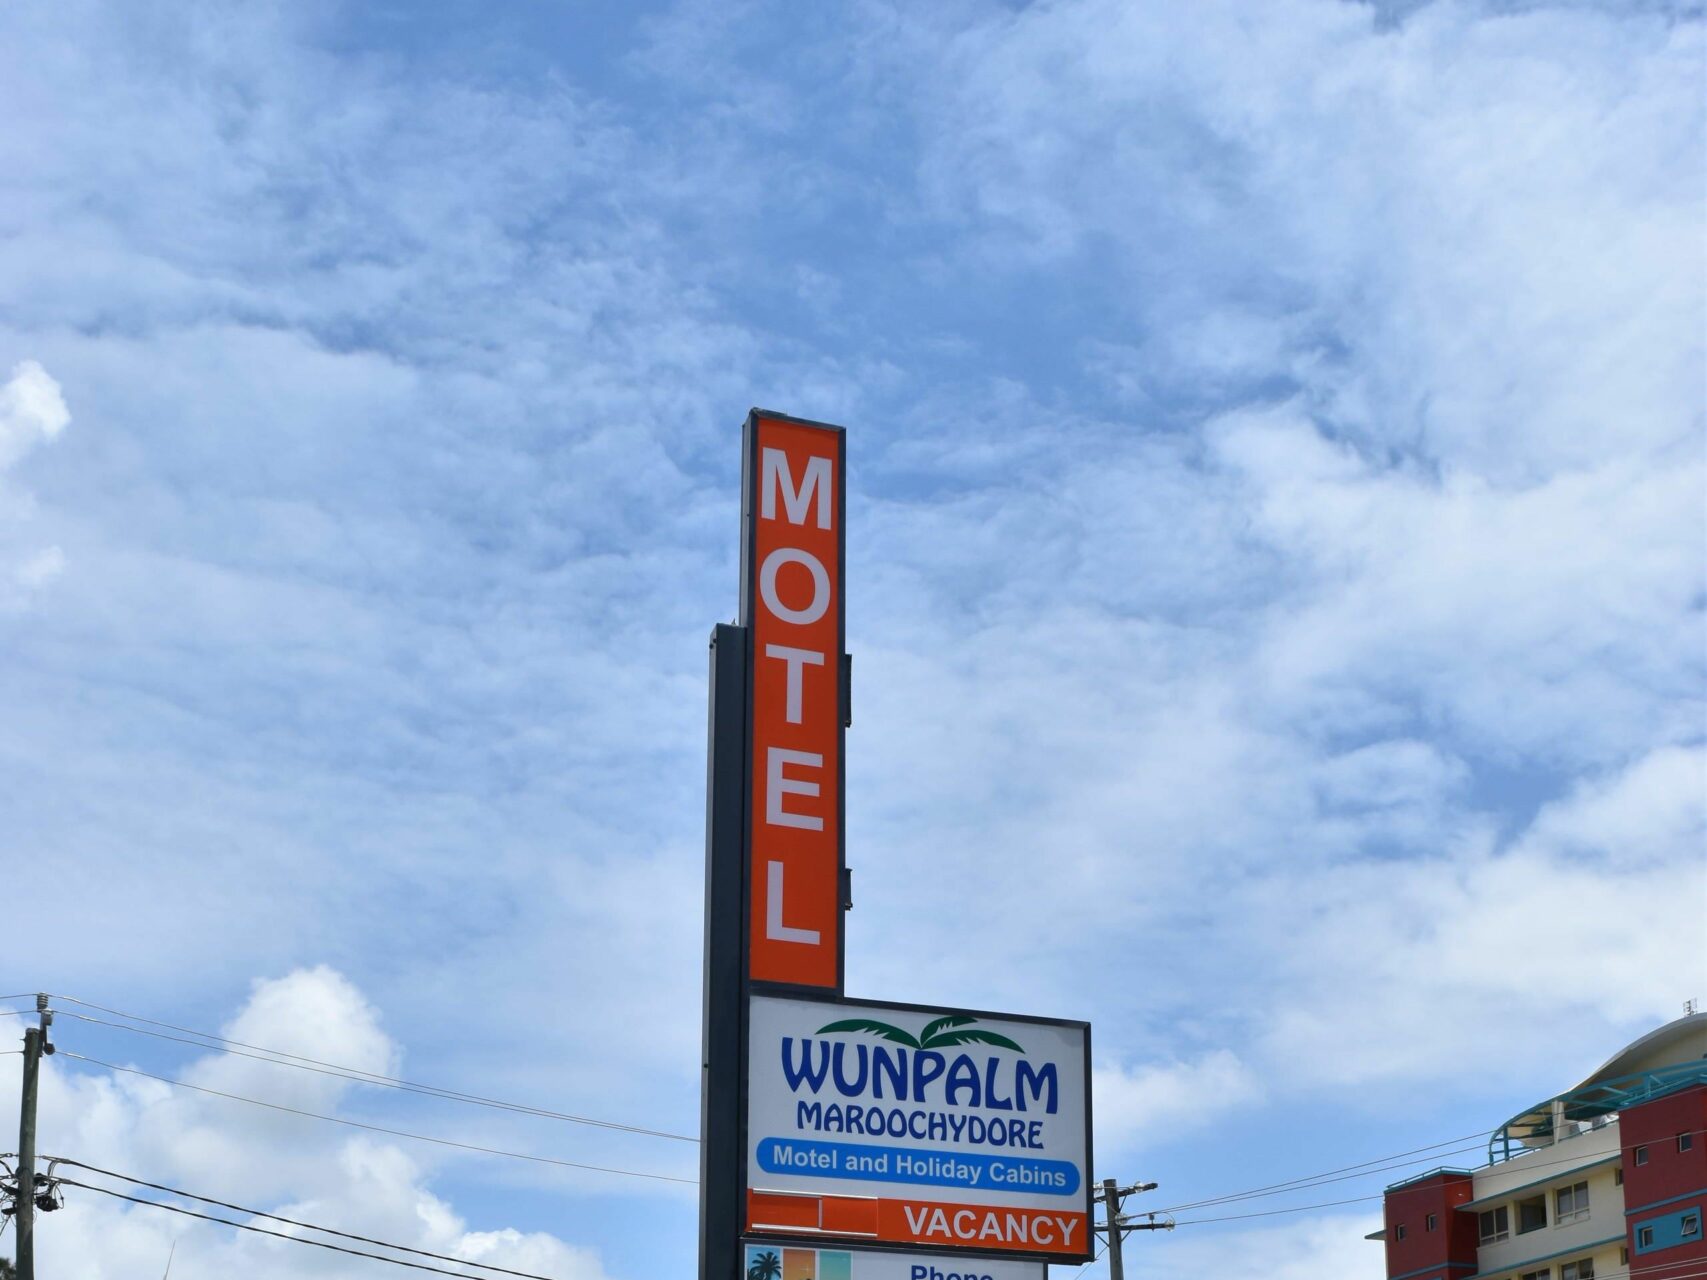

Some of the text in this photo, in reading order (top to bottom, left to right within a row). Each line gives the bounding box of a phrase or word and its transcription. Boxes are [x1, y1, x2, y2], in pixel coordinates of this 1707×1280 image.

[759, 447, 832, 946] MOTEL
[781, 1037, 1059, 1114] WUNPALM
[797, 1100, 1044, 1149] MAROOCHYDORE
[773, 1145, 1067, 1187] Motel and Holiday Cabins
[903, 1206, 1079, 1246] VACANCY
